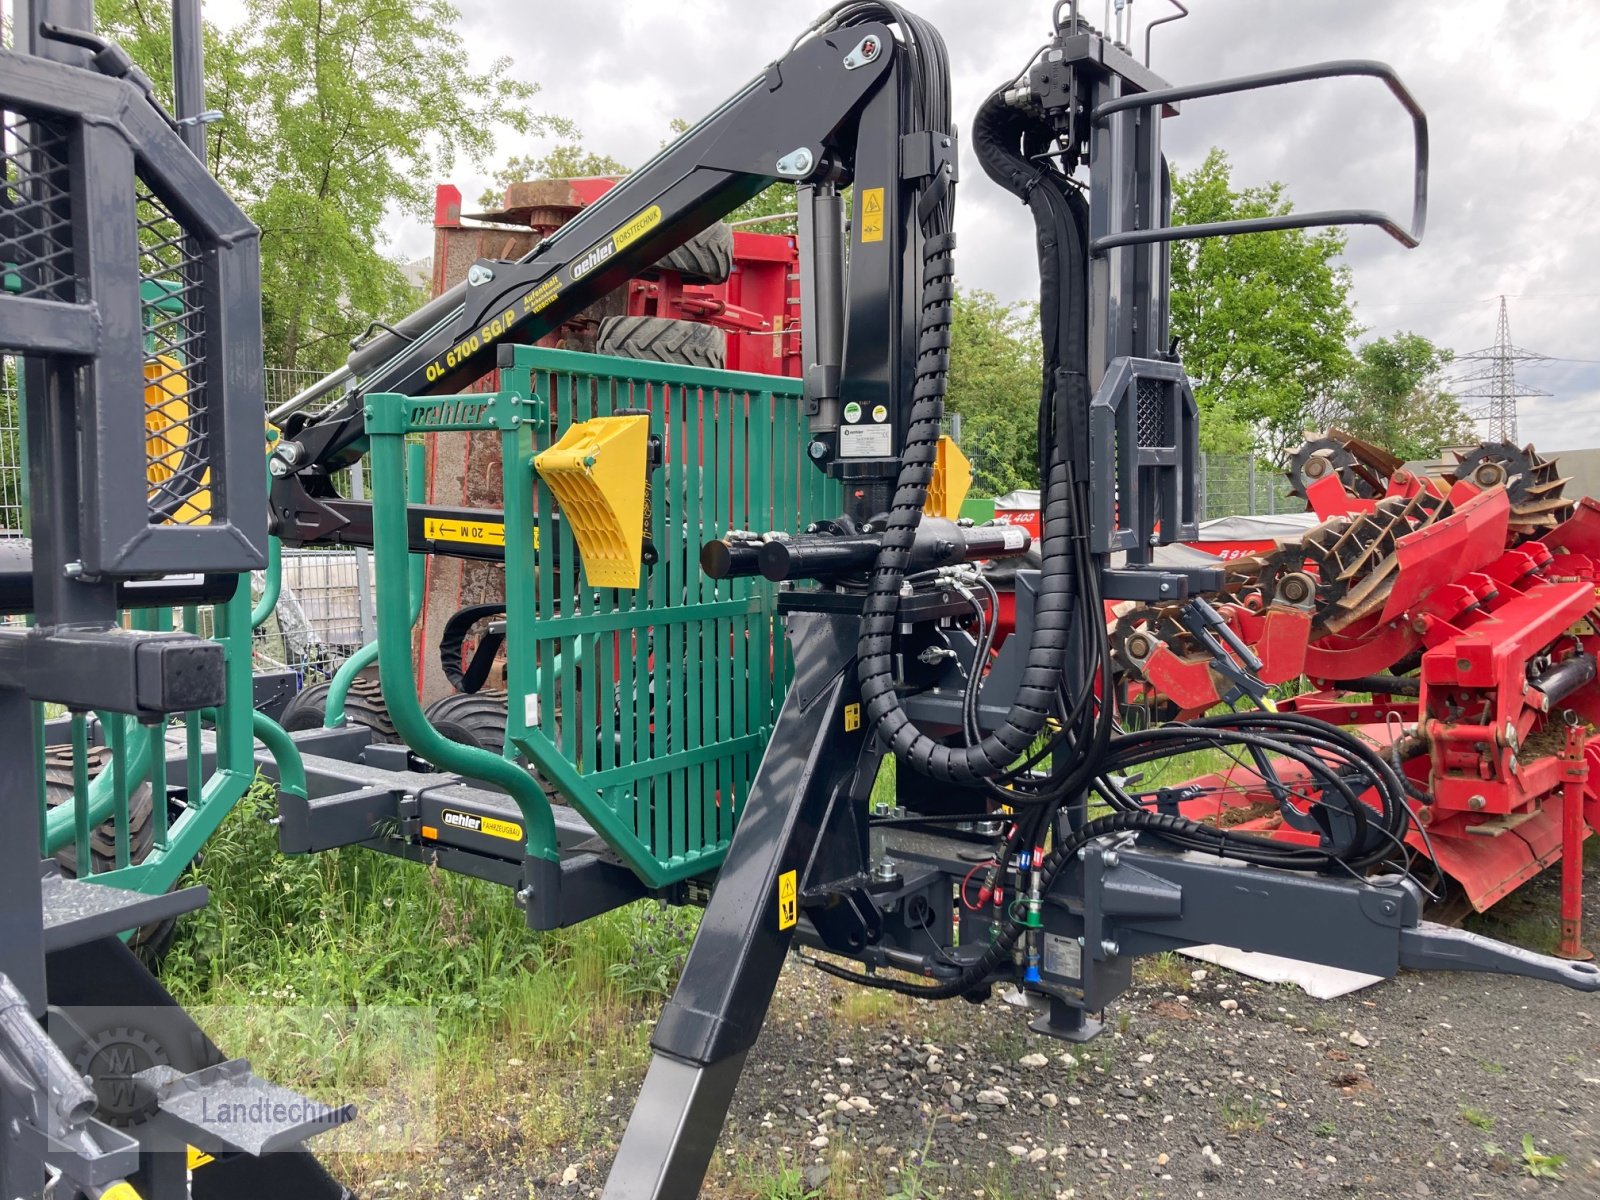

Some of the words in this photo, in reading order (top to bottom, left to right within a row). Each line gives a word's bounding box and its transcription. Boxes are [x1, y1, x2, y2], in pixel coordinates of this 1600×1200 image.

[573, 241, 614, 279] oehler
[615, 209, 659, 246] FORSTTECHNIK
[523, 275, 559, 305] Aufenthalt
[532, 293, 559, 314] VERBOTEN
[425, 361, 445, 382] OL
[446, 335, 479, 368] 6700
[481, 309, 516, 344] SG/P
[460, 526, 469, 537] M
[471, 527, 484, 538] 20
[444, 812, 481, 830] oehler
[482, 821, 520, 837] FAHRZEUGBAU
